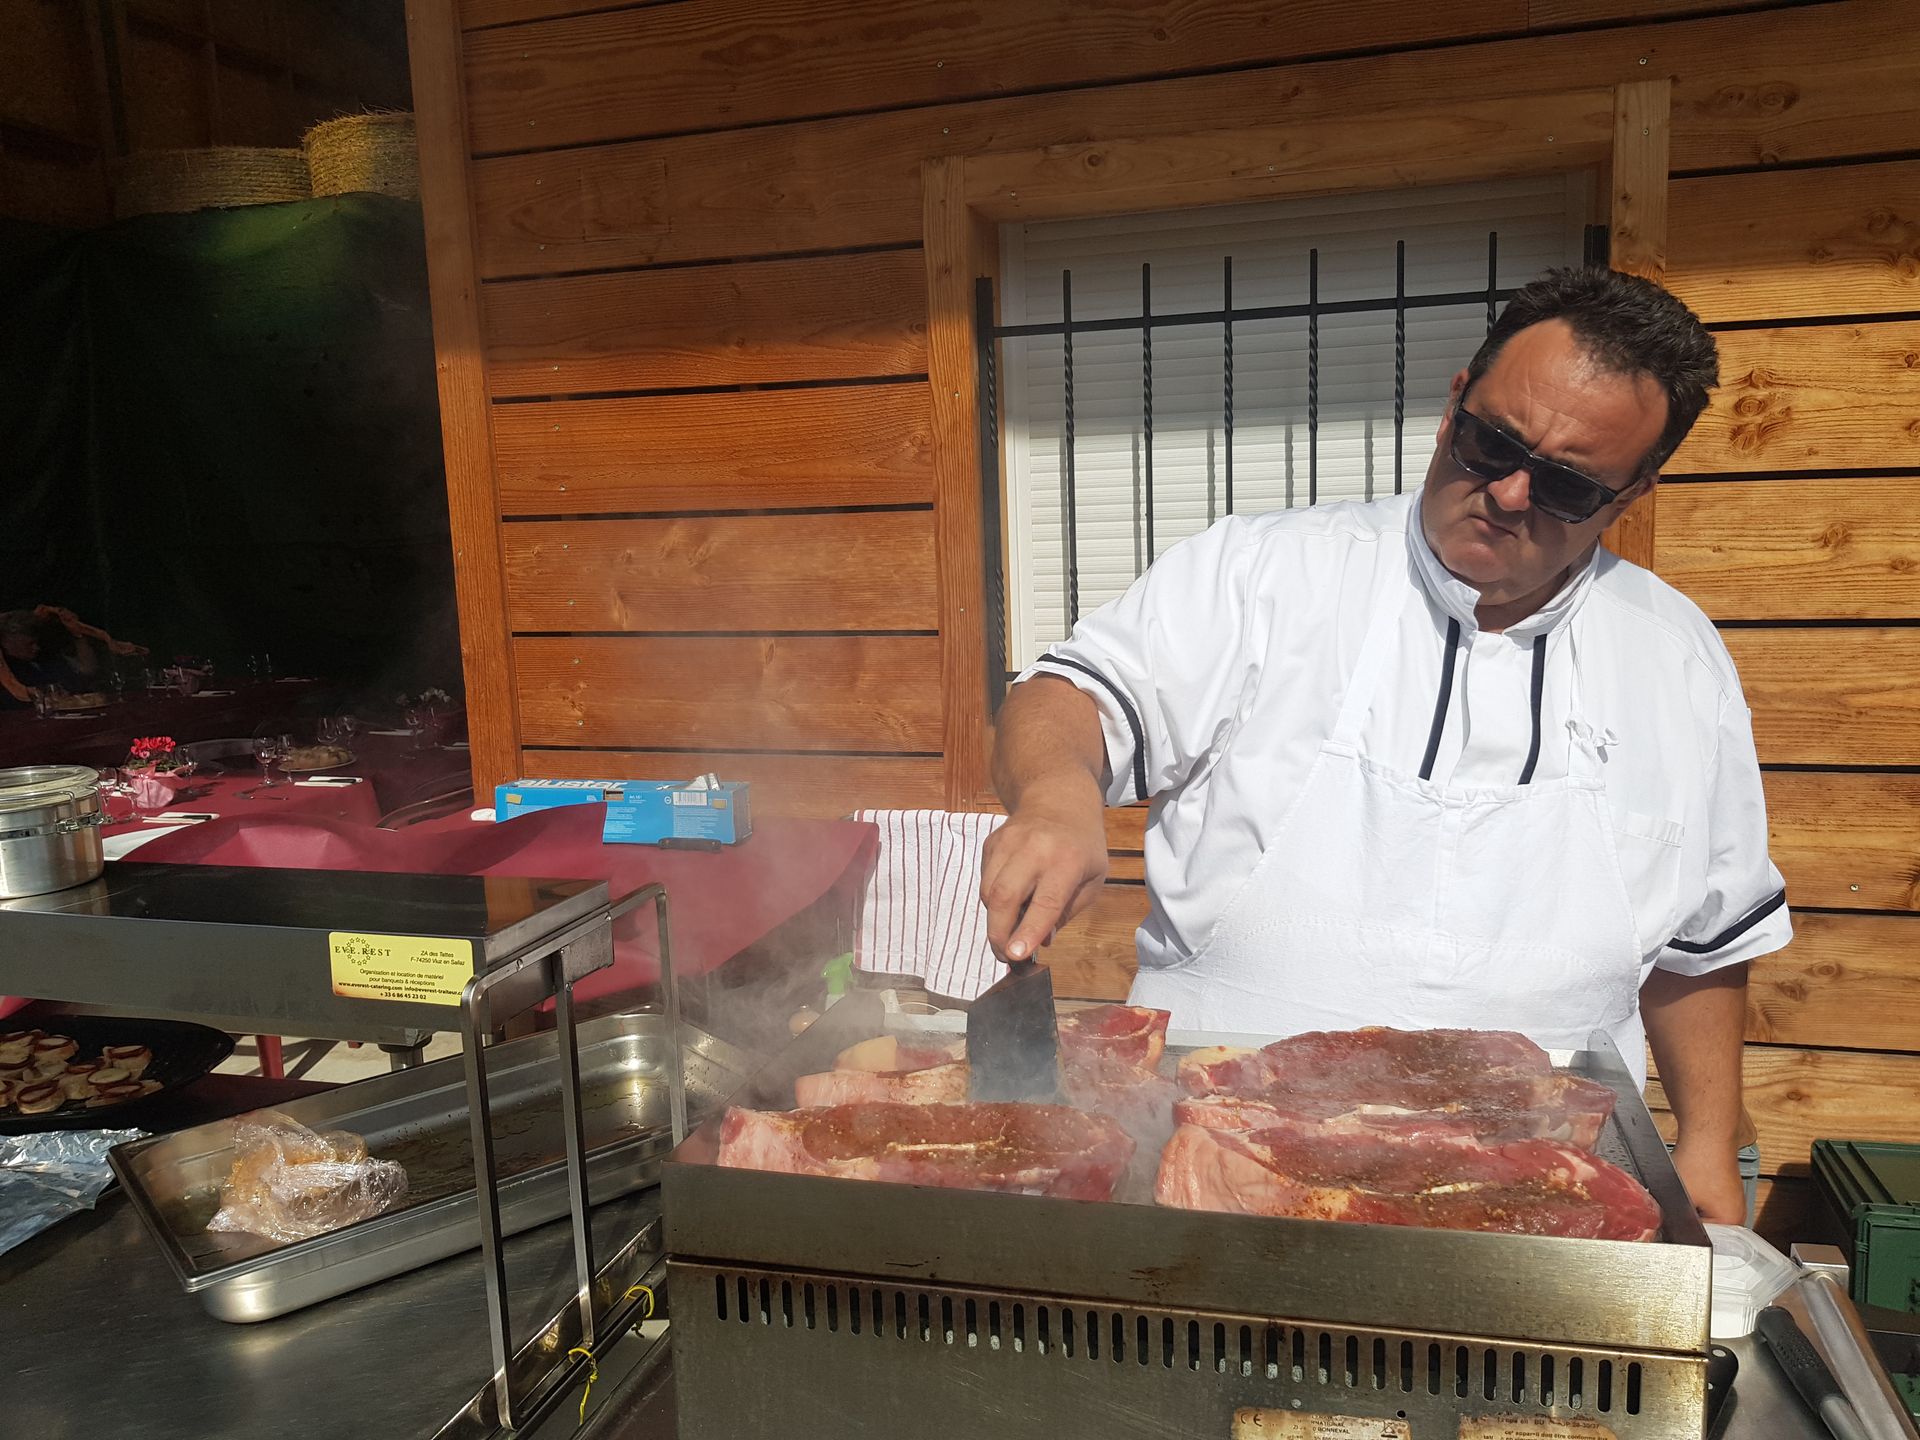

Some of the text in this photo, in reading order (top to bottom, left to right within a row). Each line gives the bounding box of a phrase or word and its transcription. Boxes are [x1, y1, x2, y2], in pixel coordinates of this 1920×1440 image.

[513, 778, 628, 791] alustar
[359, 968, 390, 976] Organisation
[381, 977, 404, 985] banquets
